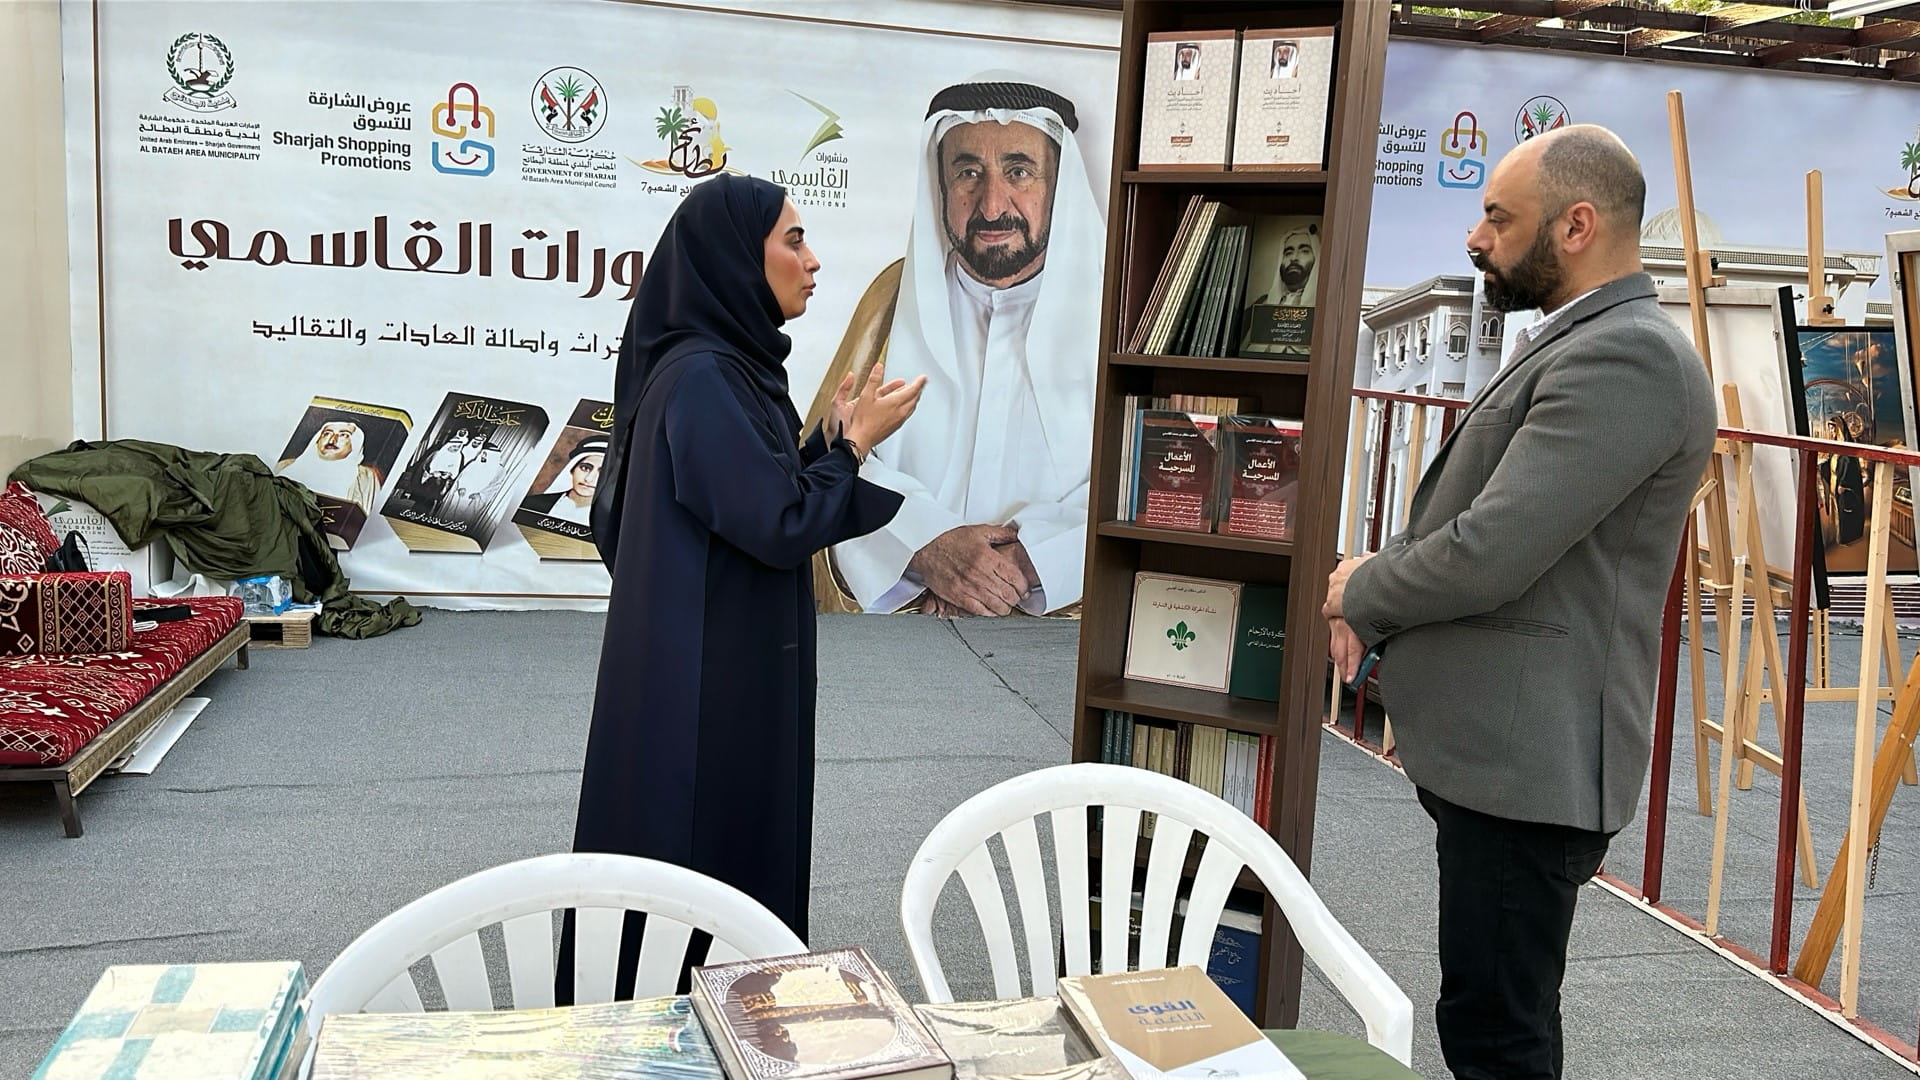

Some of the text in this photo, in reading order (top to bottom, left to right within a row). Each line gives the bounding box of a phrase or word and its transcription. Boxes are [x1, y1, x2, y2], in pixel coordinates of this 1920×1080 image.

[308, 91, 411, 115] عروض الشارقة
[353, 114, 411, 131] للتسوق
[138, 123, 260, 141] بلدية منطقة البطائح
[1395, 125, 1427, 140] عروض
[173, 138, 198, 146] Emirates
[205, 141, 226, 149] Sharjah
[227, 142, 261, 151] Government
[273, 131, 411, 157] Sharjah Shopping
[1383, 140, 1426, 154] للتسوق
[140, 145, 260, 161] AL BATAEH AREA MUNICIPALITY
[816, 152, 848, 164] منشورات
[321, 151, 411, 171] Promotions
[1376, 159, 1424, 175] hopping
[522, 167, 617, 181] GOVERNMENT OF SHARJAH
[1374, 174, 1423, 187] motions
[550, 177, 563, 185] Area
[564, 179, 594, 188] Municipal
[594, 181, 616, 189] Council
[804, 188, 846, 199] QASIMI
[791, 199, 846, 208] ICATIONS
[168, 215, 644, 301] ورات القاسمي
[252, 315, 366, 346] والتقاليد
[377, 321, 475, 347] العادات
[569, 332, 623, 360] تراث
[1164, 450, 1192, 462] الأعمال
[1247, 458, 1276, 469] الأعمال
